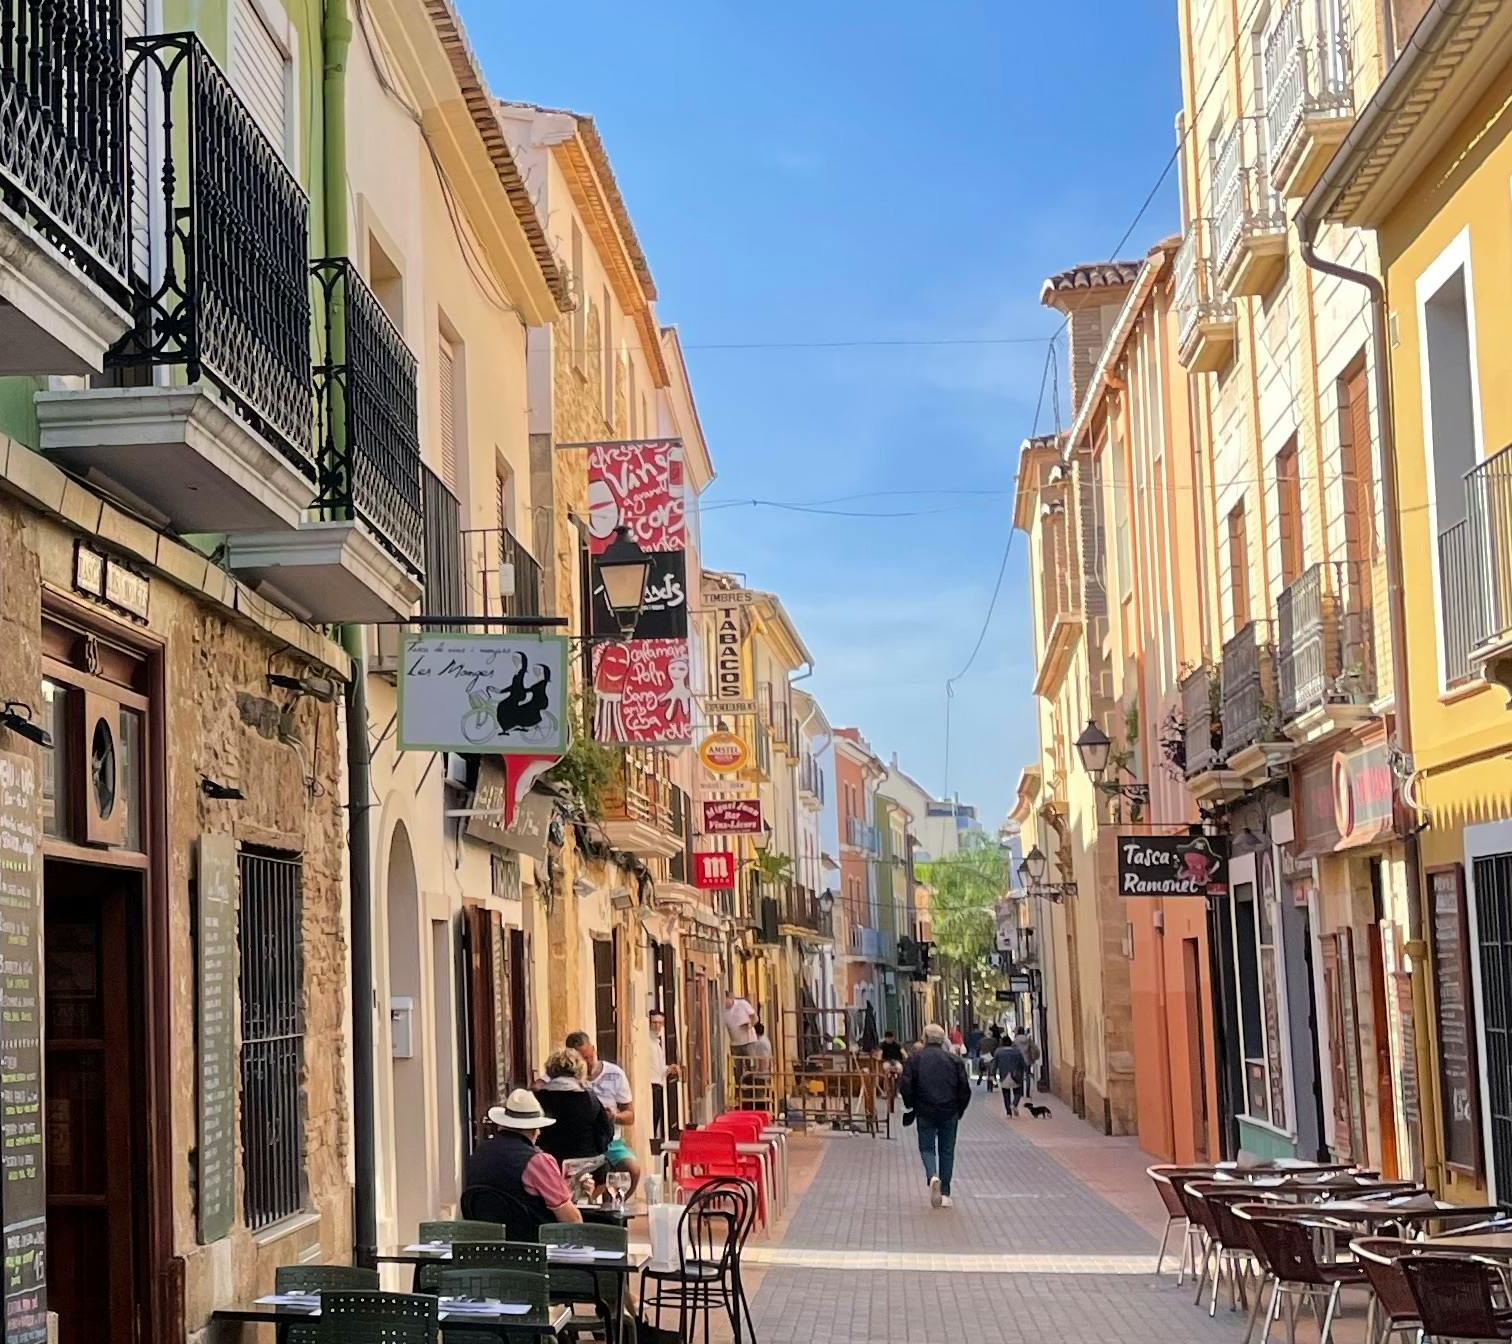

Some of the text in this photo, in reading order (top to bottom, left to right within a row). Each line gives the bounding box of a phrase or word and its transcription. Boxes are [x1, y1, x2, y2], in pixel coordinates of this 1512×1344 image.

[703, 592, 752, 603] TIMBRES
[718, 607, 740, 697] TABACOS
[709, 745, 738, 754] AMSTEL
[1123, 844, 1170, 867] Tasca
[1124, 872, 1199, 893] Ramonet
